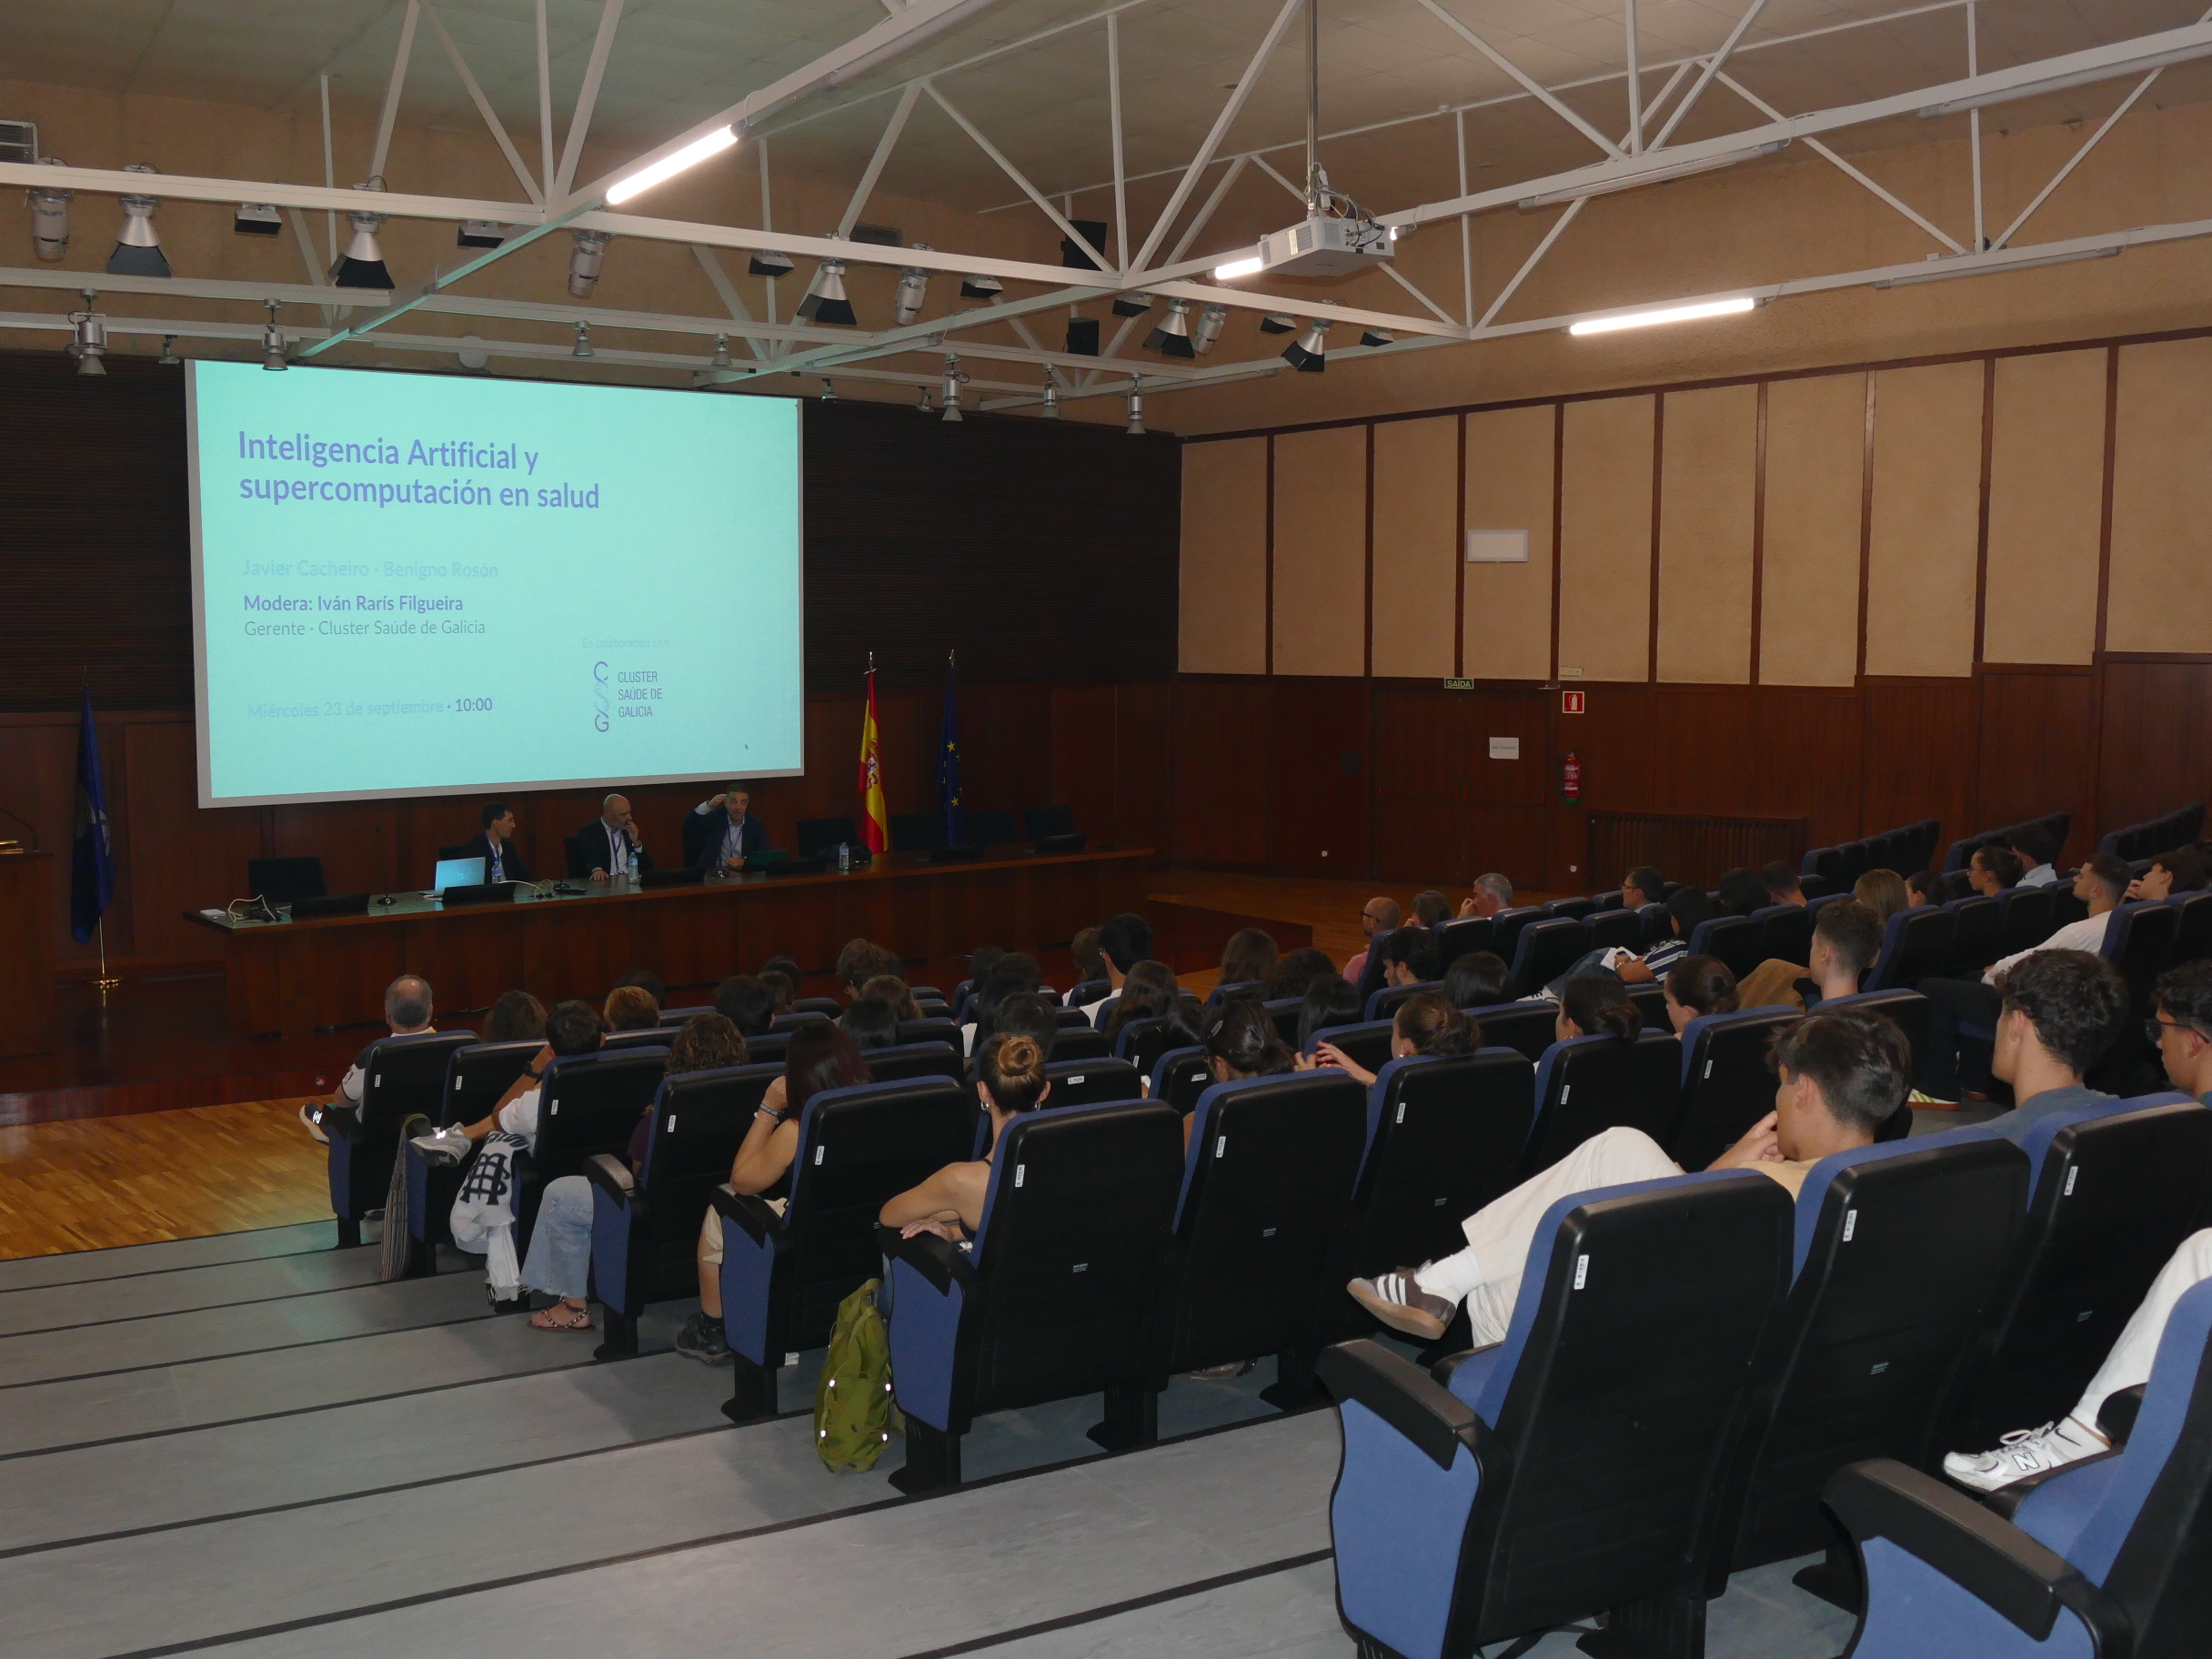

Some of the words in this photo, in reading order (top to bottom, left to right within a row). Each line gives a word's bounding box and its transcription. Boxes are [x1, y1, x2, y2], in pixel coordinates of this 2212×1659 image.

[238, 431, 400, 468] Inteligencia
[407, 439, 517, 469] Artificial
[524, 450, 538, 475] y
[239, 476, 491, 508] supercomputación
[499, 486, 529, 508] en
[537, 483, 599, 508] salud
[242, 559, 292, 576] Javier
[297, 560, 369, 578] Cacheiro
[384, 561, 447, 580] Benigno
[451, 562, 498, 578] Rosón
[243, 595, 313, 611] Modera:
[317, 595, 351, 611] Iván
[356, 596, 395, 611] Rarís
[399, 596, 464, 614] Filgueira
[244, 621, 306, 636] Gerente
[318, 621, 370, 635] Cluster
[374, 620, 417, 635] Saúde
[420, 620, 437, 635] de
[441, 620, 486, 635] Galicia
[618, 670, 658, 683] CLUSTER
[1447, 679, 1471, 688] SAÍDA
[618, 686, 649, 701] SAÚDE
[650, 688, 662, 700] DE
[247, 703, 319, 719] Miércoles
[322, 702, 341, 717] 23
[345, 700, 362, 716] de
[366, 699, 443, 717] septiembre
[454, 697, 493, 713] 10:00
[618, 705, 653, 718] GALICIA
